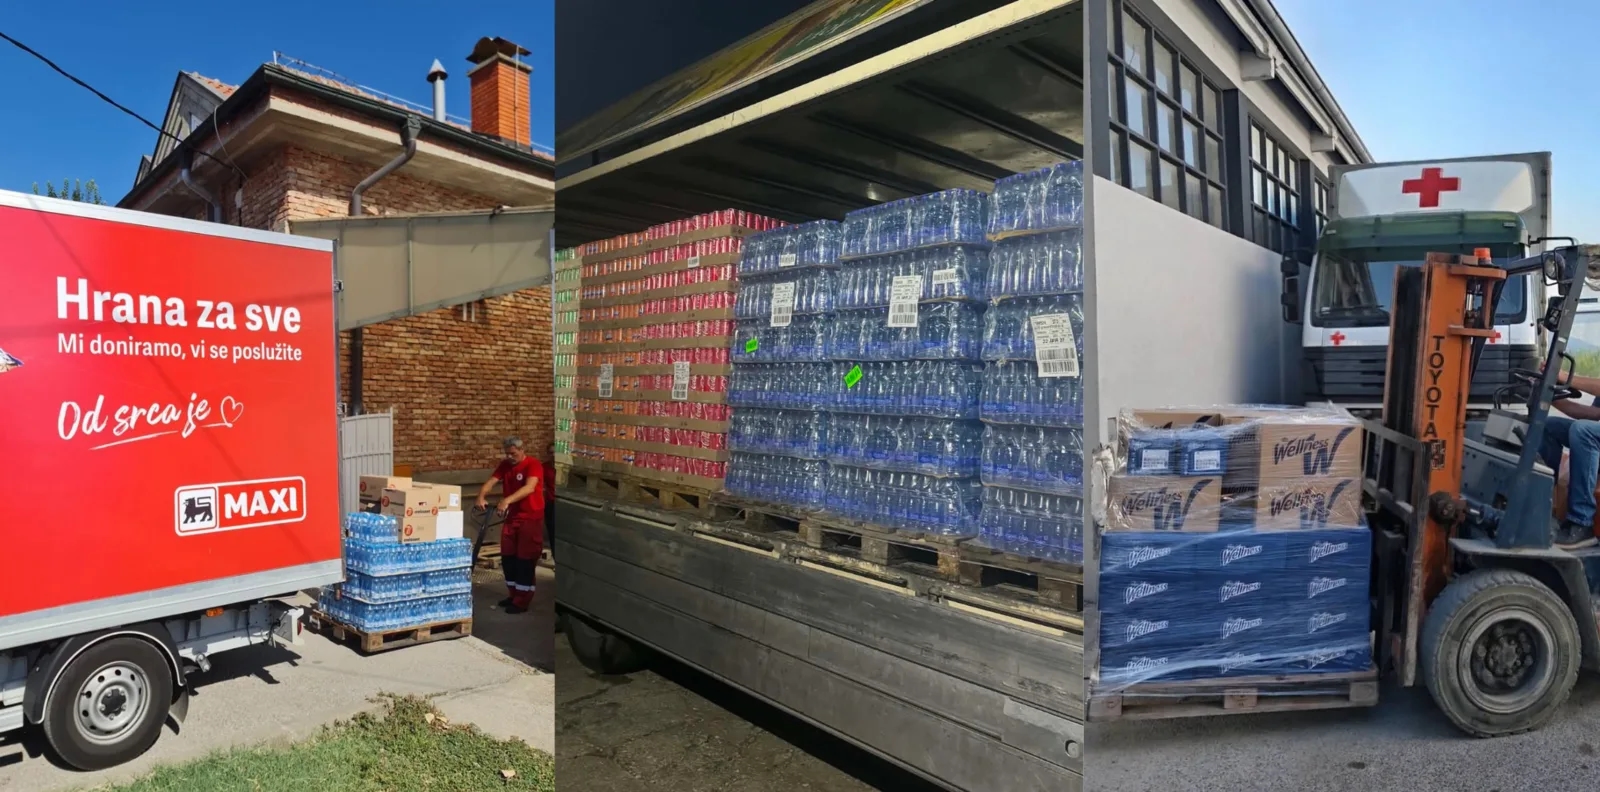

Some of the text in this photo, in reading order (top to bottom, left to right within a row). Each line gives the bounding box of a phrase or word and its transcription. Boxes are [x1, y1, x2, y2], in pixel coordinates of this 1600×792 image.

[56, 276, 302, 334] Hrana za sve
[58, 333, 302, 363] Mi doniramo, vi se poslužite
[1422, 335, 1445, 438] TOYOTA
[57, 392, 211, 440] Od srca je
[1273, 433, 1329, 465] Wellness
[223, 486, 298, 520] MAXI
[1128, 546, 1171, 568] Wellness
[1221, 545, 1263, 567] Wellness
[1309, 541, 1348, 563] Wellness
[1125, 582, 1169, 604] Wellness
[1219, 581, 1261, 603] Wellness
[1126, 619, 1169, 642] Wellness
[1221, 617, 1263, 640] Wellness
